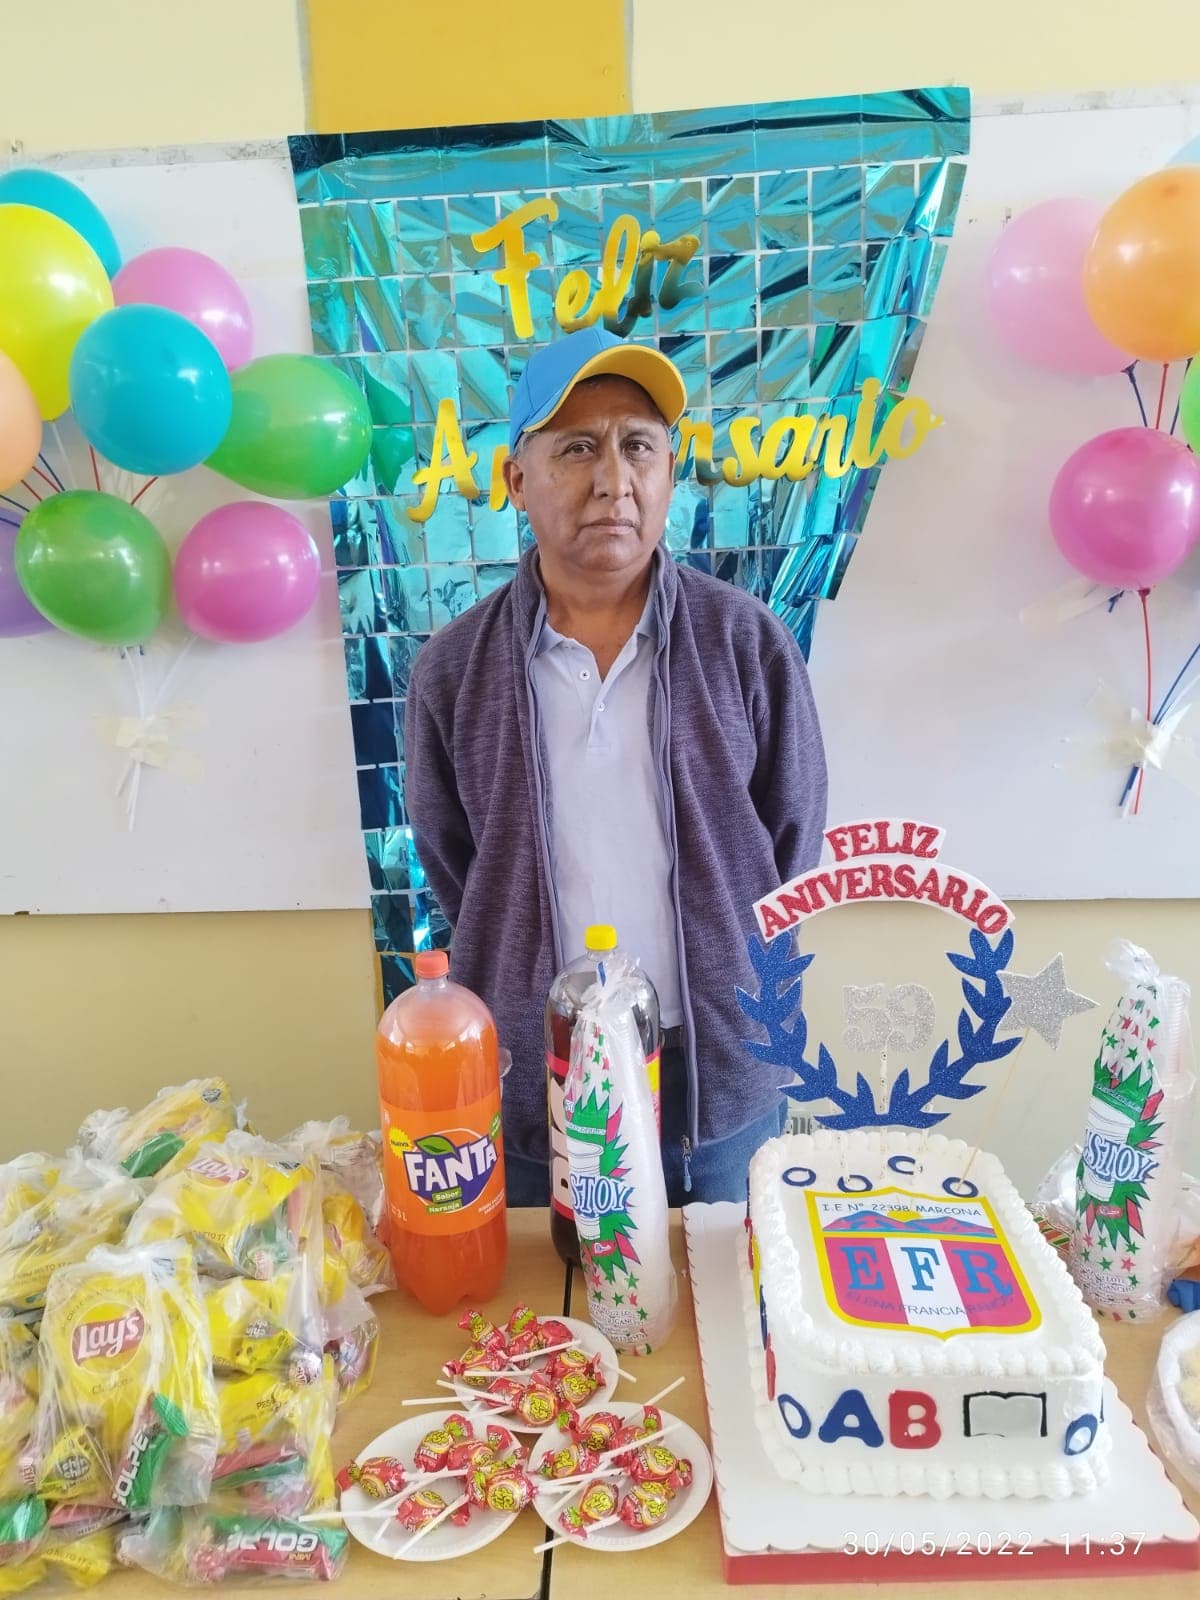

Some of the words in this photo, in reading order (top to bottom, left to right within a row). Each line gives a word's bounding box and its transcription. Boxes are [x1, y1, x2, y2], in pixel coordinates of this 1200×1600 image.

[471, 197, 703, 339] Feliz
[825, 820, 939, 862] FELIZ
[759, 863, 1008, 938] ANIVERSARIO
[842, 983, 936, 1051] 59
[404, 1136, 498, 1192] FANTA
[428, 1202, 461, 1213] Naranja
[435, 1190, 460, 1201] Sabor
[915, 1205, 982, 1216] MARCONA
